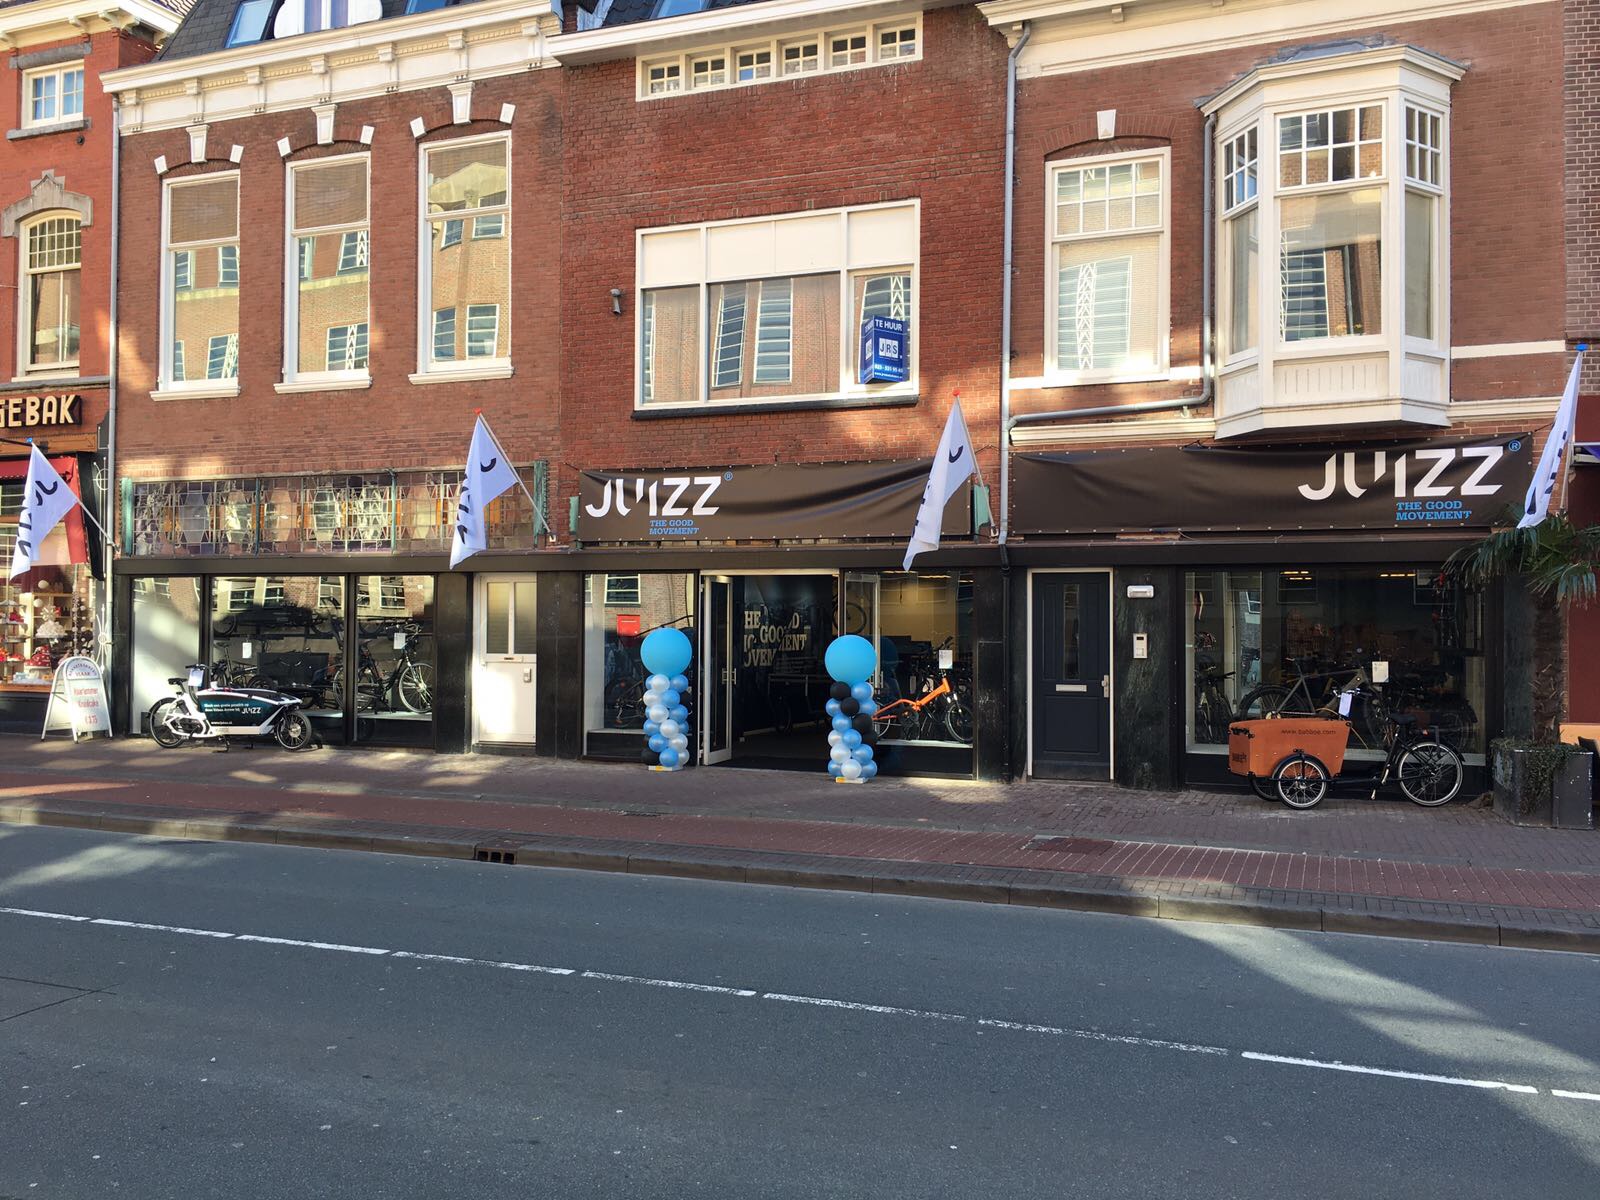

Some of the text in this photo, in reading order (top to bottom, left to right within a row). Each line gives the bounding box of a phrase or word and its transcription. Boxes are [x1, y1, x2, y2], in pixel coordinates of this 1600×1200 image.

[874, 319, 883, 328] TE
[884, 320, 903, 331] HUUR
[880, 343, 898, 354] JRS
[1297, 446, 1504, 501] JUIZZ
[585, 476, 722, 518] JUIZZ
[1396, 501, 1462, 511] THE GOOD
[1395, 510, 1472, 521] MOVEMENT
[650, 519, 694, 527] THE GOOD
[649, 527, 699, 535] MOVEMENT
